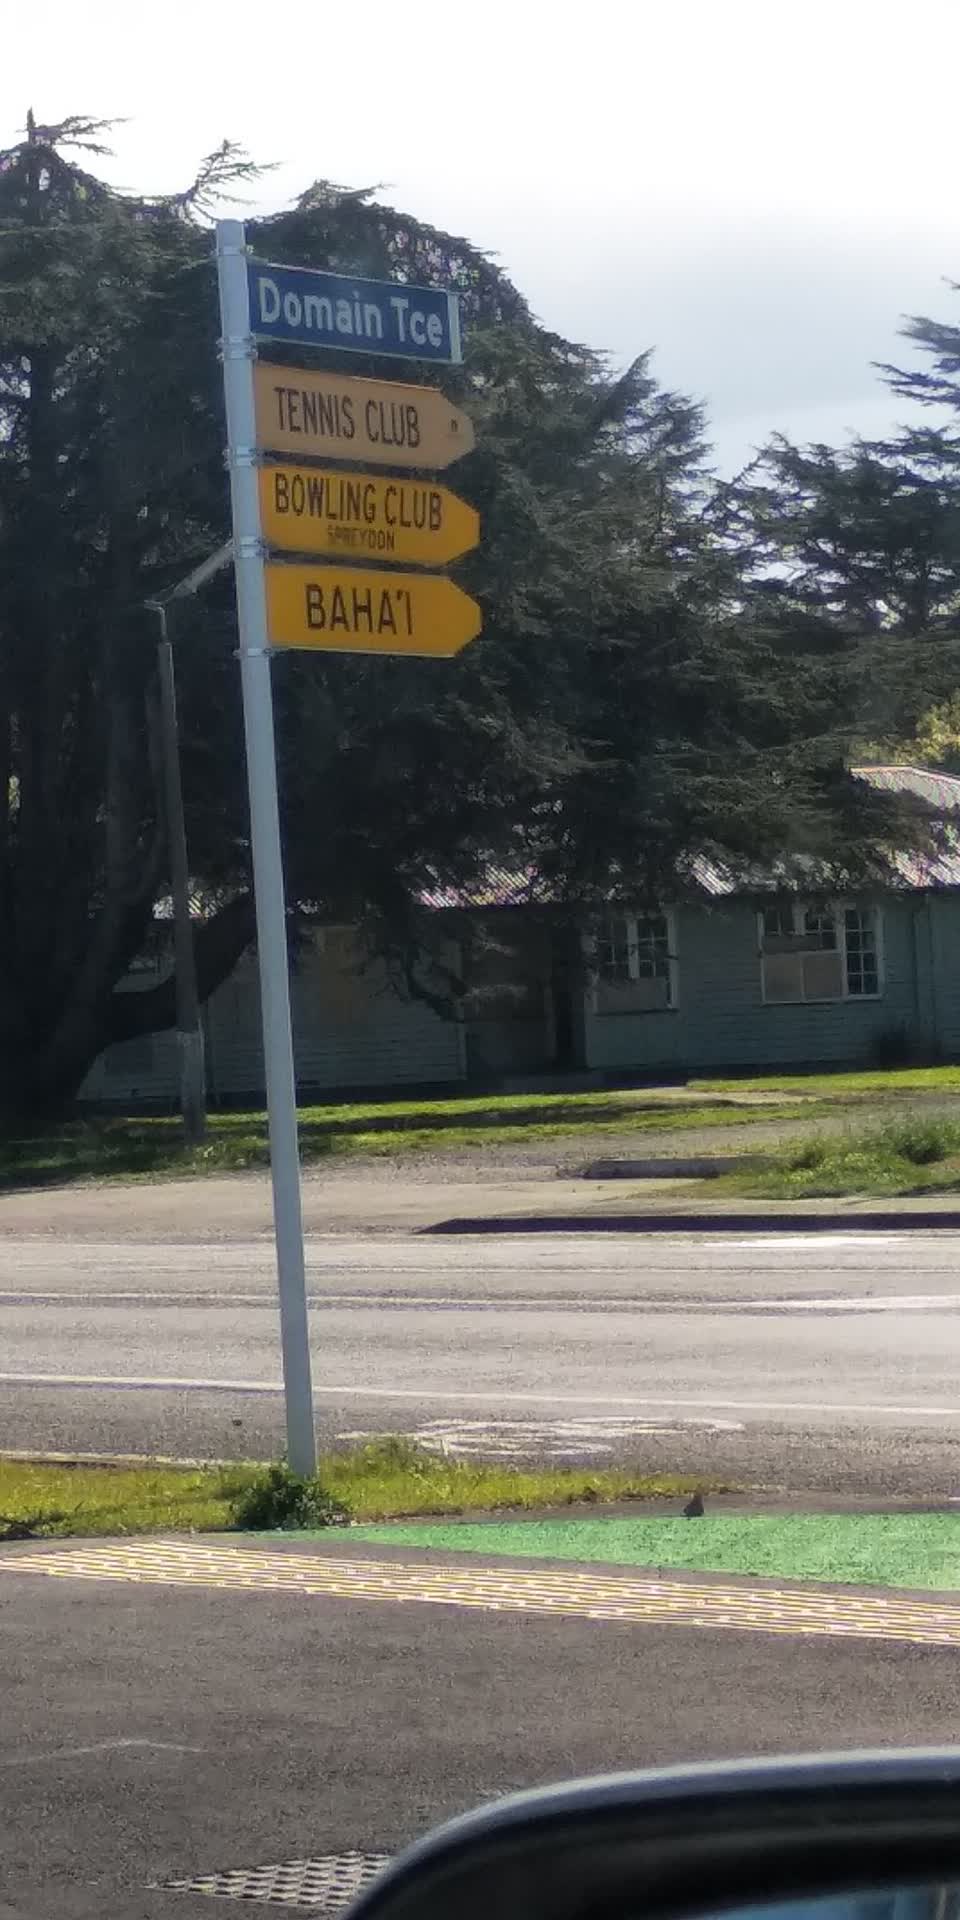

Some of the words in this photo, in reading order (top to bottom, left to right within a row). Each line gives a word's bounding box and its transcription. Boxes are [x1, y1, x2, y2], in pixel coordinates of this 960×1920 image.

[257, 276, 383, 339] Domain
[390, 296, 443, 348] Tce
[274, 386, 355, 440] TENNIS
[365, 399, 421, 448] CLUB
[275, 472, 377, 524] BOWLING
[384, 485, 442, 531] CLUB
[305, 583, 413, 635] BAHA'I
